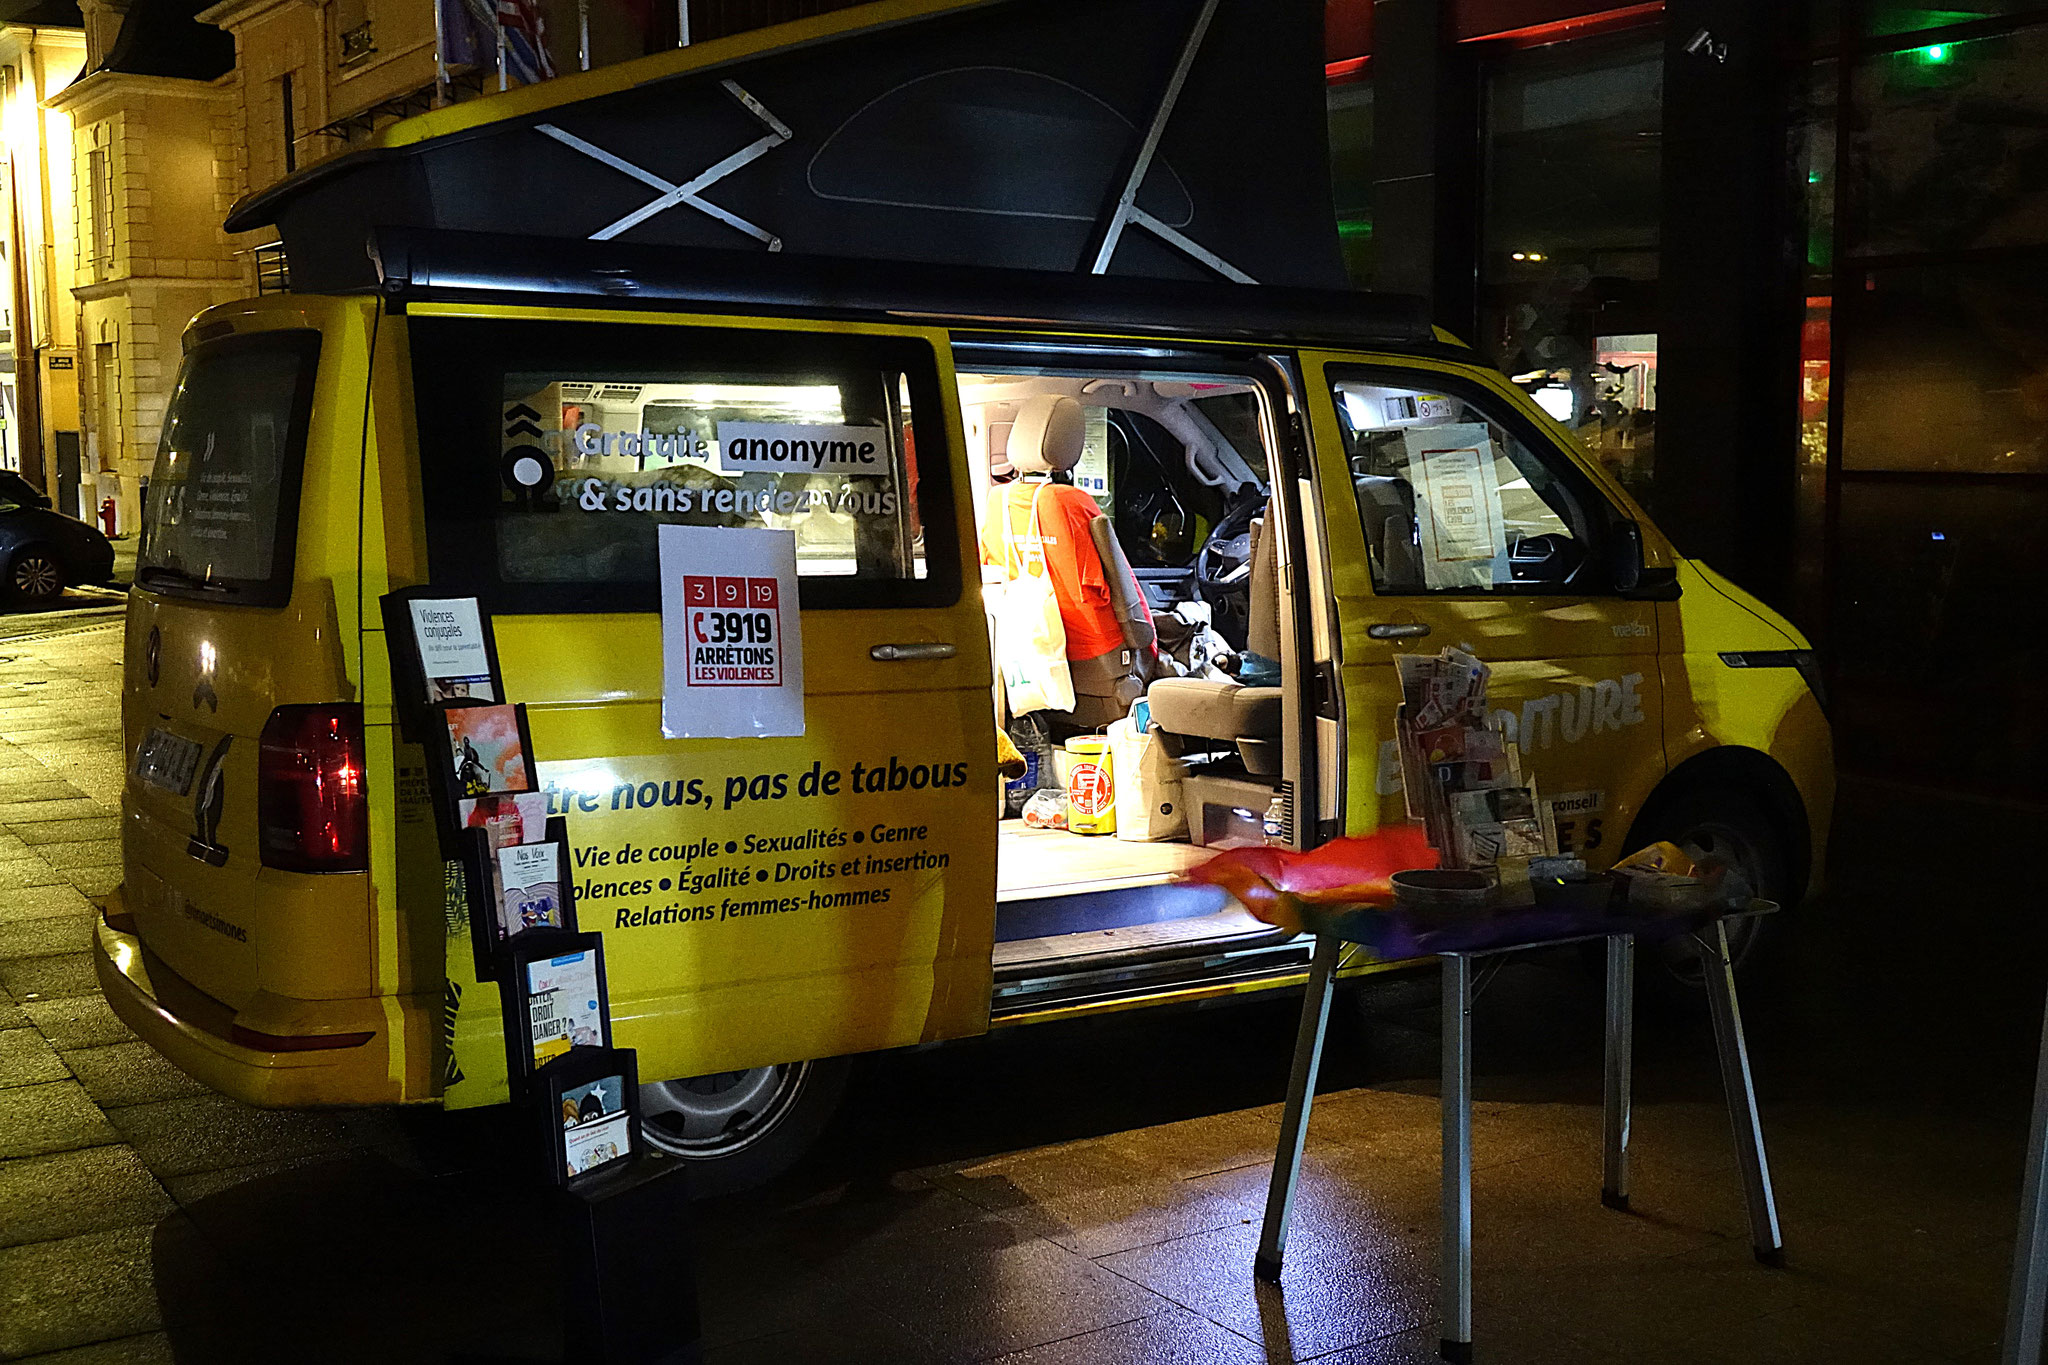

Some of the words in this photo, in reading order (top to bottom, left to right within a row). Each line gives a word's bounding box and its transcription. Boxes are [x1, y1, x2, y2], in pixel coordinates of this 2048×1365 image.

[728, 436, 876, 469] anonyme
[579, 479, 607, 512] &
[616, 487, 694, 512] sans
[693, 584, 705, 600] 3
[725, 584, 737, 601] 9
[754, 585, 772, 602] 19
[420, 608, 455, 623] Violences
[424, 623, 463, 640] conjugales
[710, 612, 772, 643] 3919
[694, 644, 774, 665] ARRÊTONS
[695, 667, 715, 680] LES
[716, 667, 774, 680] VIOLENCES
[610, 777, 713, 811] nous,
[723, 771, 789, 811] pas
[797, 760, 841, 798] de
[850, 756, 968, 794] tabous
[1552, 792, 1598, 812] conseil
[516, 849, 529, 861] Nos
[531, 847, 545, 859] Voix
[573, 846, 610, 868] Vie
[616, 843, 643, 865] de
[648, 837, 719, 863] couple
[743, 827, 848, 854] Sexualités
[870, 823, 928, 844] Genre
[572, 878, 653, 901] olences
[678, 864, 750, 895] Égalité
[774, 859, 836, 882] Droits
[840, 857, 861, 876] et
[865, 850, 950, 875] insertion
[615, 903, 715, 929] Relations
[720, 888, 891, 922] femmes-hommes
[532, 1003, 554, 1023] DROIT
[533, 1018, 561, 1041] DANGER
